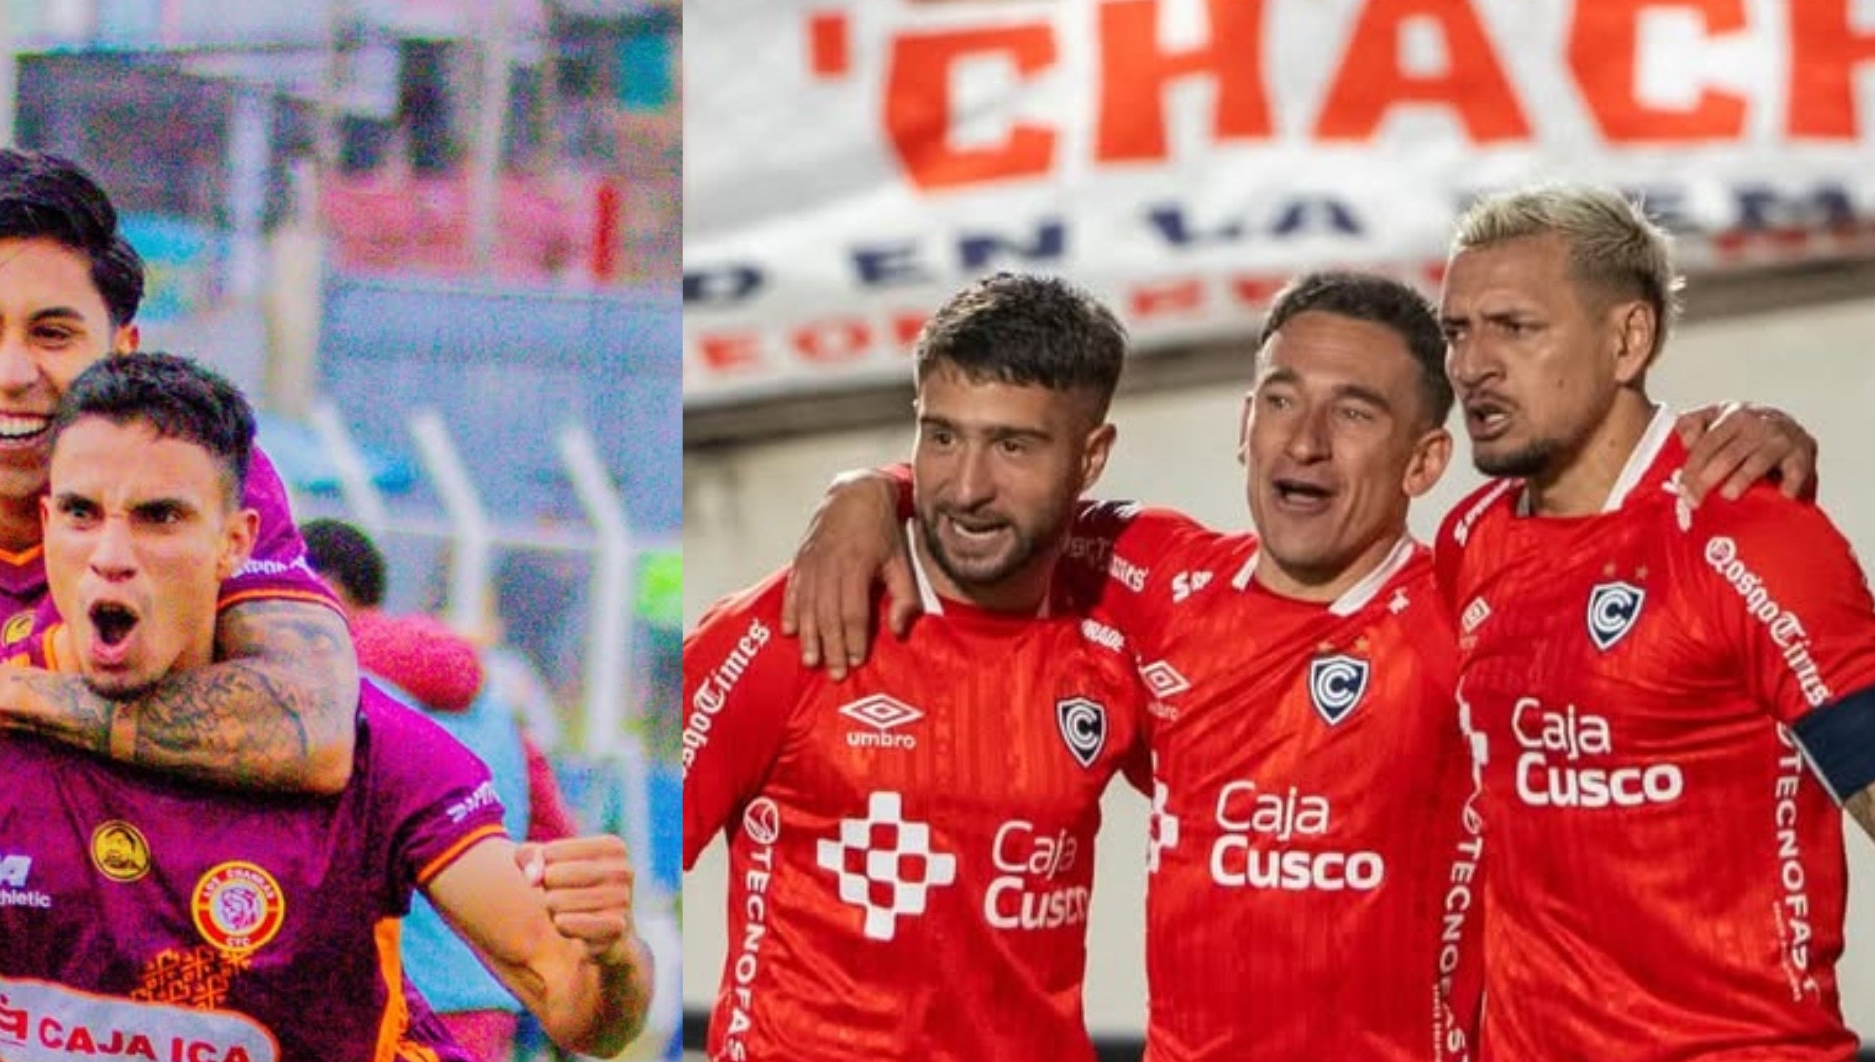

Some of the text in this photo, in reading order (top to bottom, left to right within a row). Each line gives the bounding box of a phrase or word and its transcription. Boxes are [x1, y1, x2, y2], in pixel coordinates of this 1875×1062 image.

[846, 730, 917, 749] umbro
[1511, 696, 1613, 762] Caja
[1214, 780, 1330, 842] Caja
[1515, 760, 1684, 808] Cusco
[992, 820, 1077, 882] Caja
[1209, 834, 1385, 891] Cusco
[38, 1017, 158, 1062] CAJA
